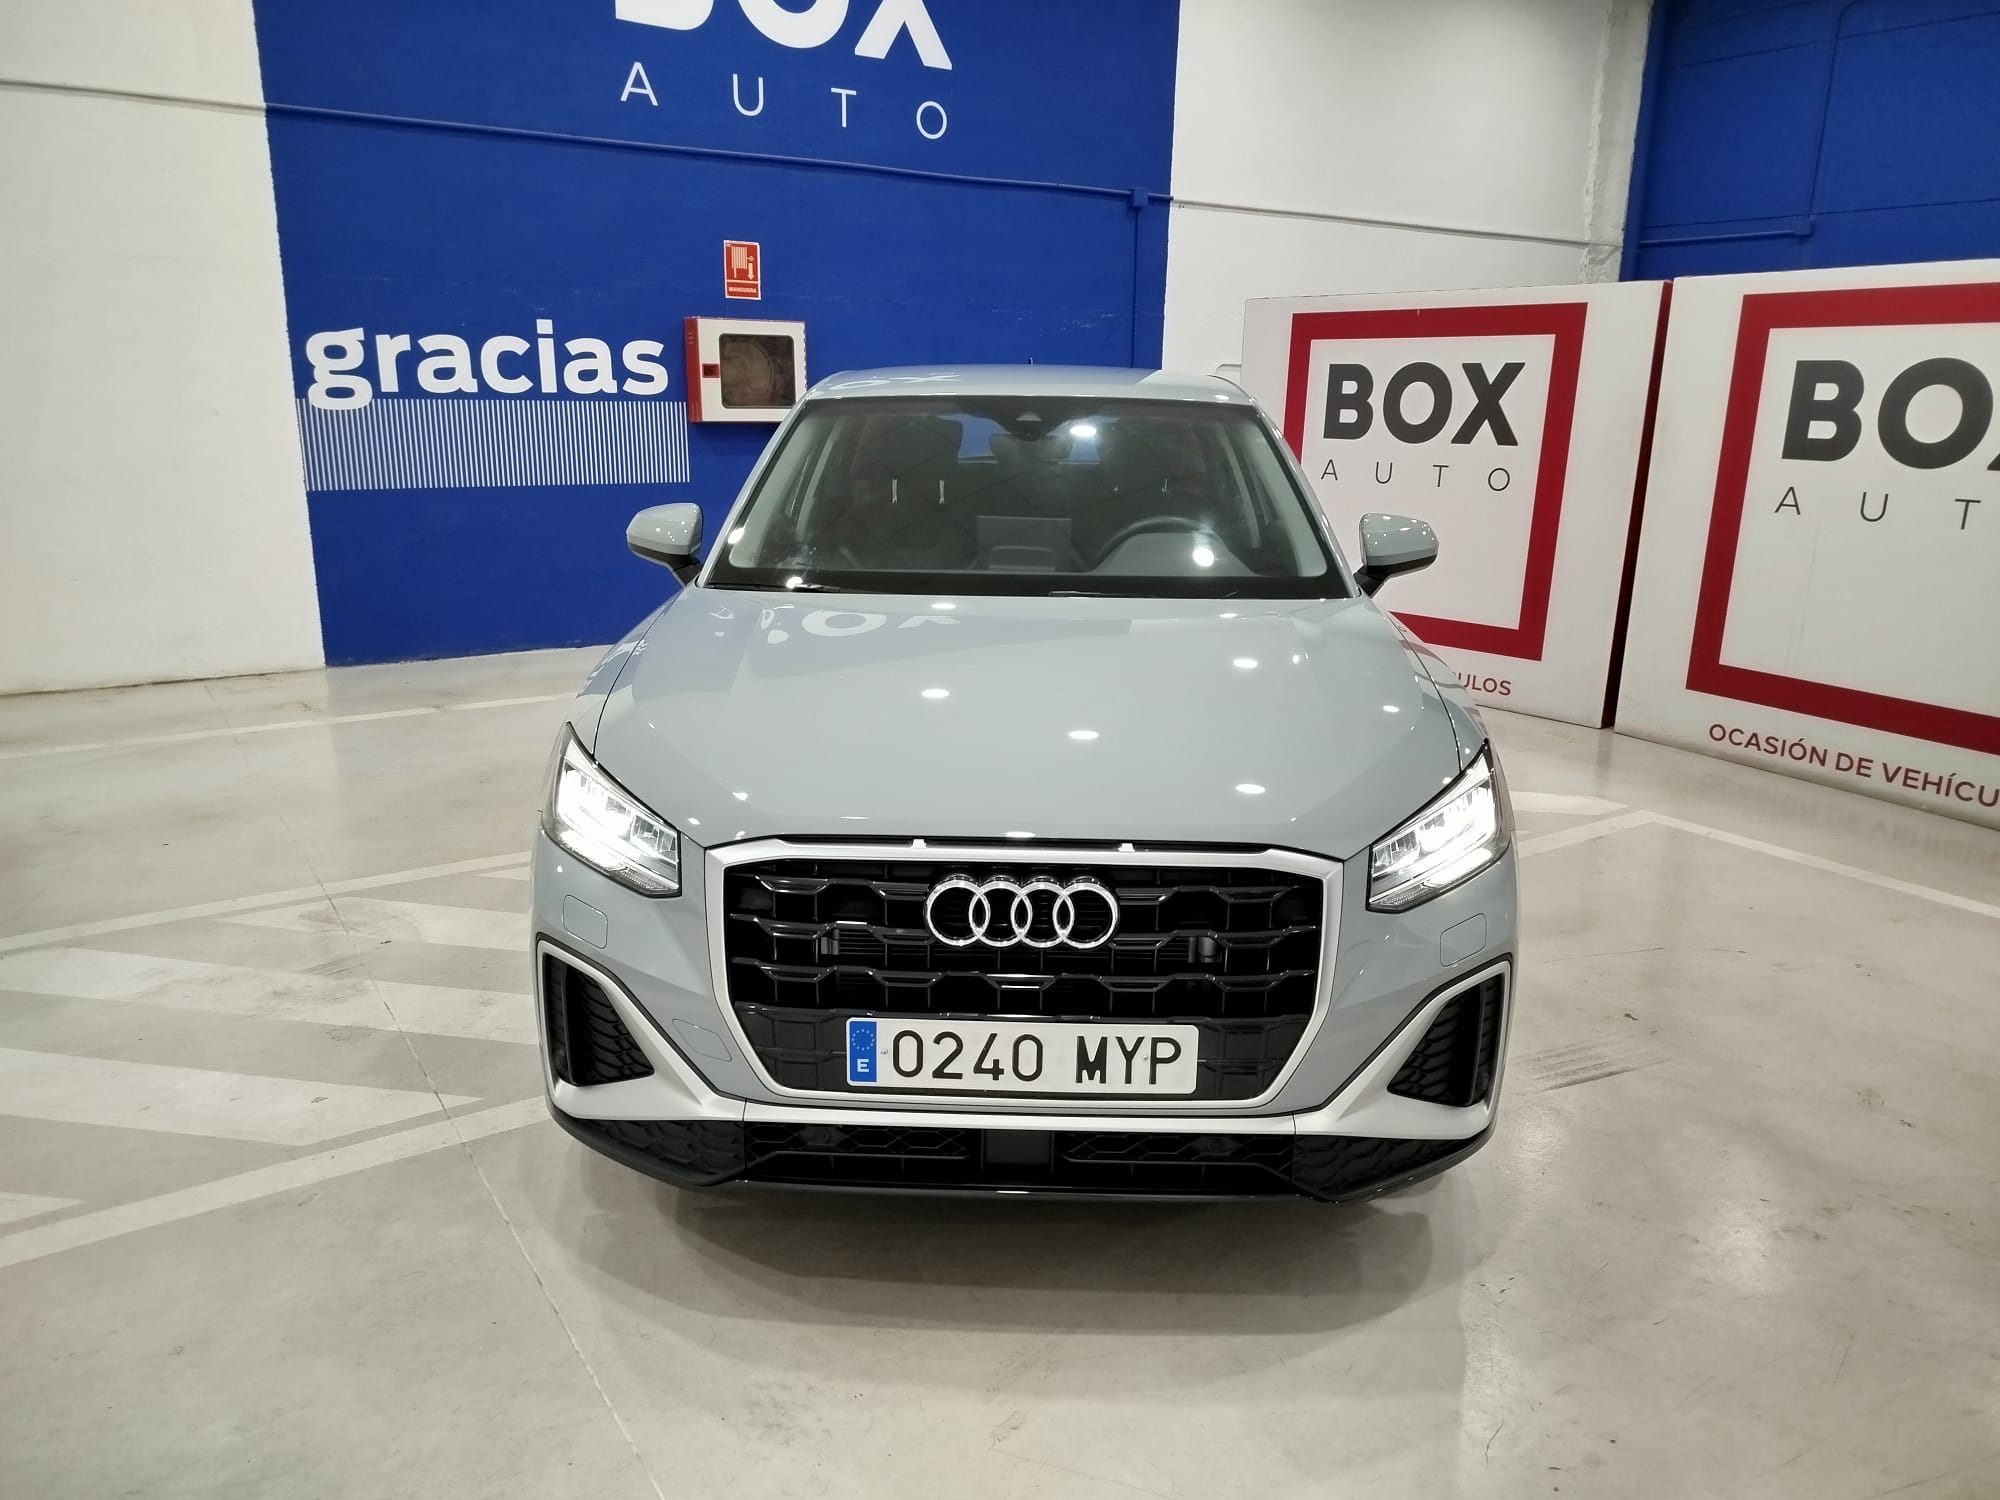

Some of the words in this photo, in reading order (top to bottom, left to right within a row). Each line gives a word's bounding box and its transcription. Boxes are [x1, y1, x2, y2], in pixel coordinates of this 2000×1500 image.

[620, 62, 948, 140] AUTO
[305, 318, 669, 411] gracias
[1323, 361, 1526, 447] BOX
[1781, 357, 2000, 471] BO
[1320, 458, 1511, 492] AUTO
[1774, 486, 1982, 531] AUT
[1457, 671, 1512, 697] ULOS
[1709, 723, 1828, 767] OCASIÓN
[1835, 752, 1874, 778] DE
[1882, 761, 2000, 808] VEHÍCU
[857, 1059, 870, 1073] E
[892, 1029, 1044, 1082] 0240
[1075, 1035, 1182, 1085] MYP
